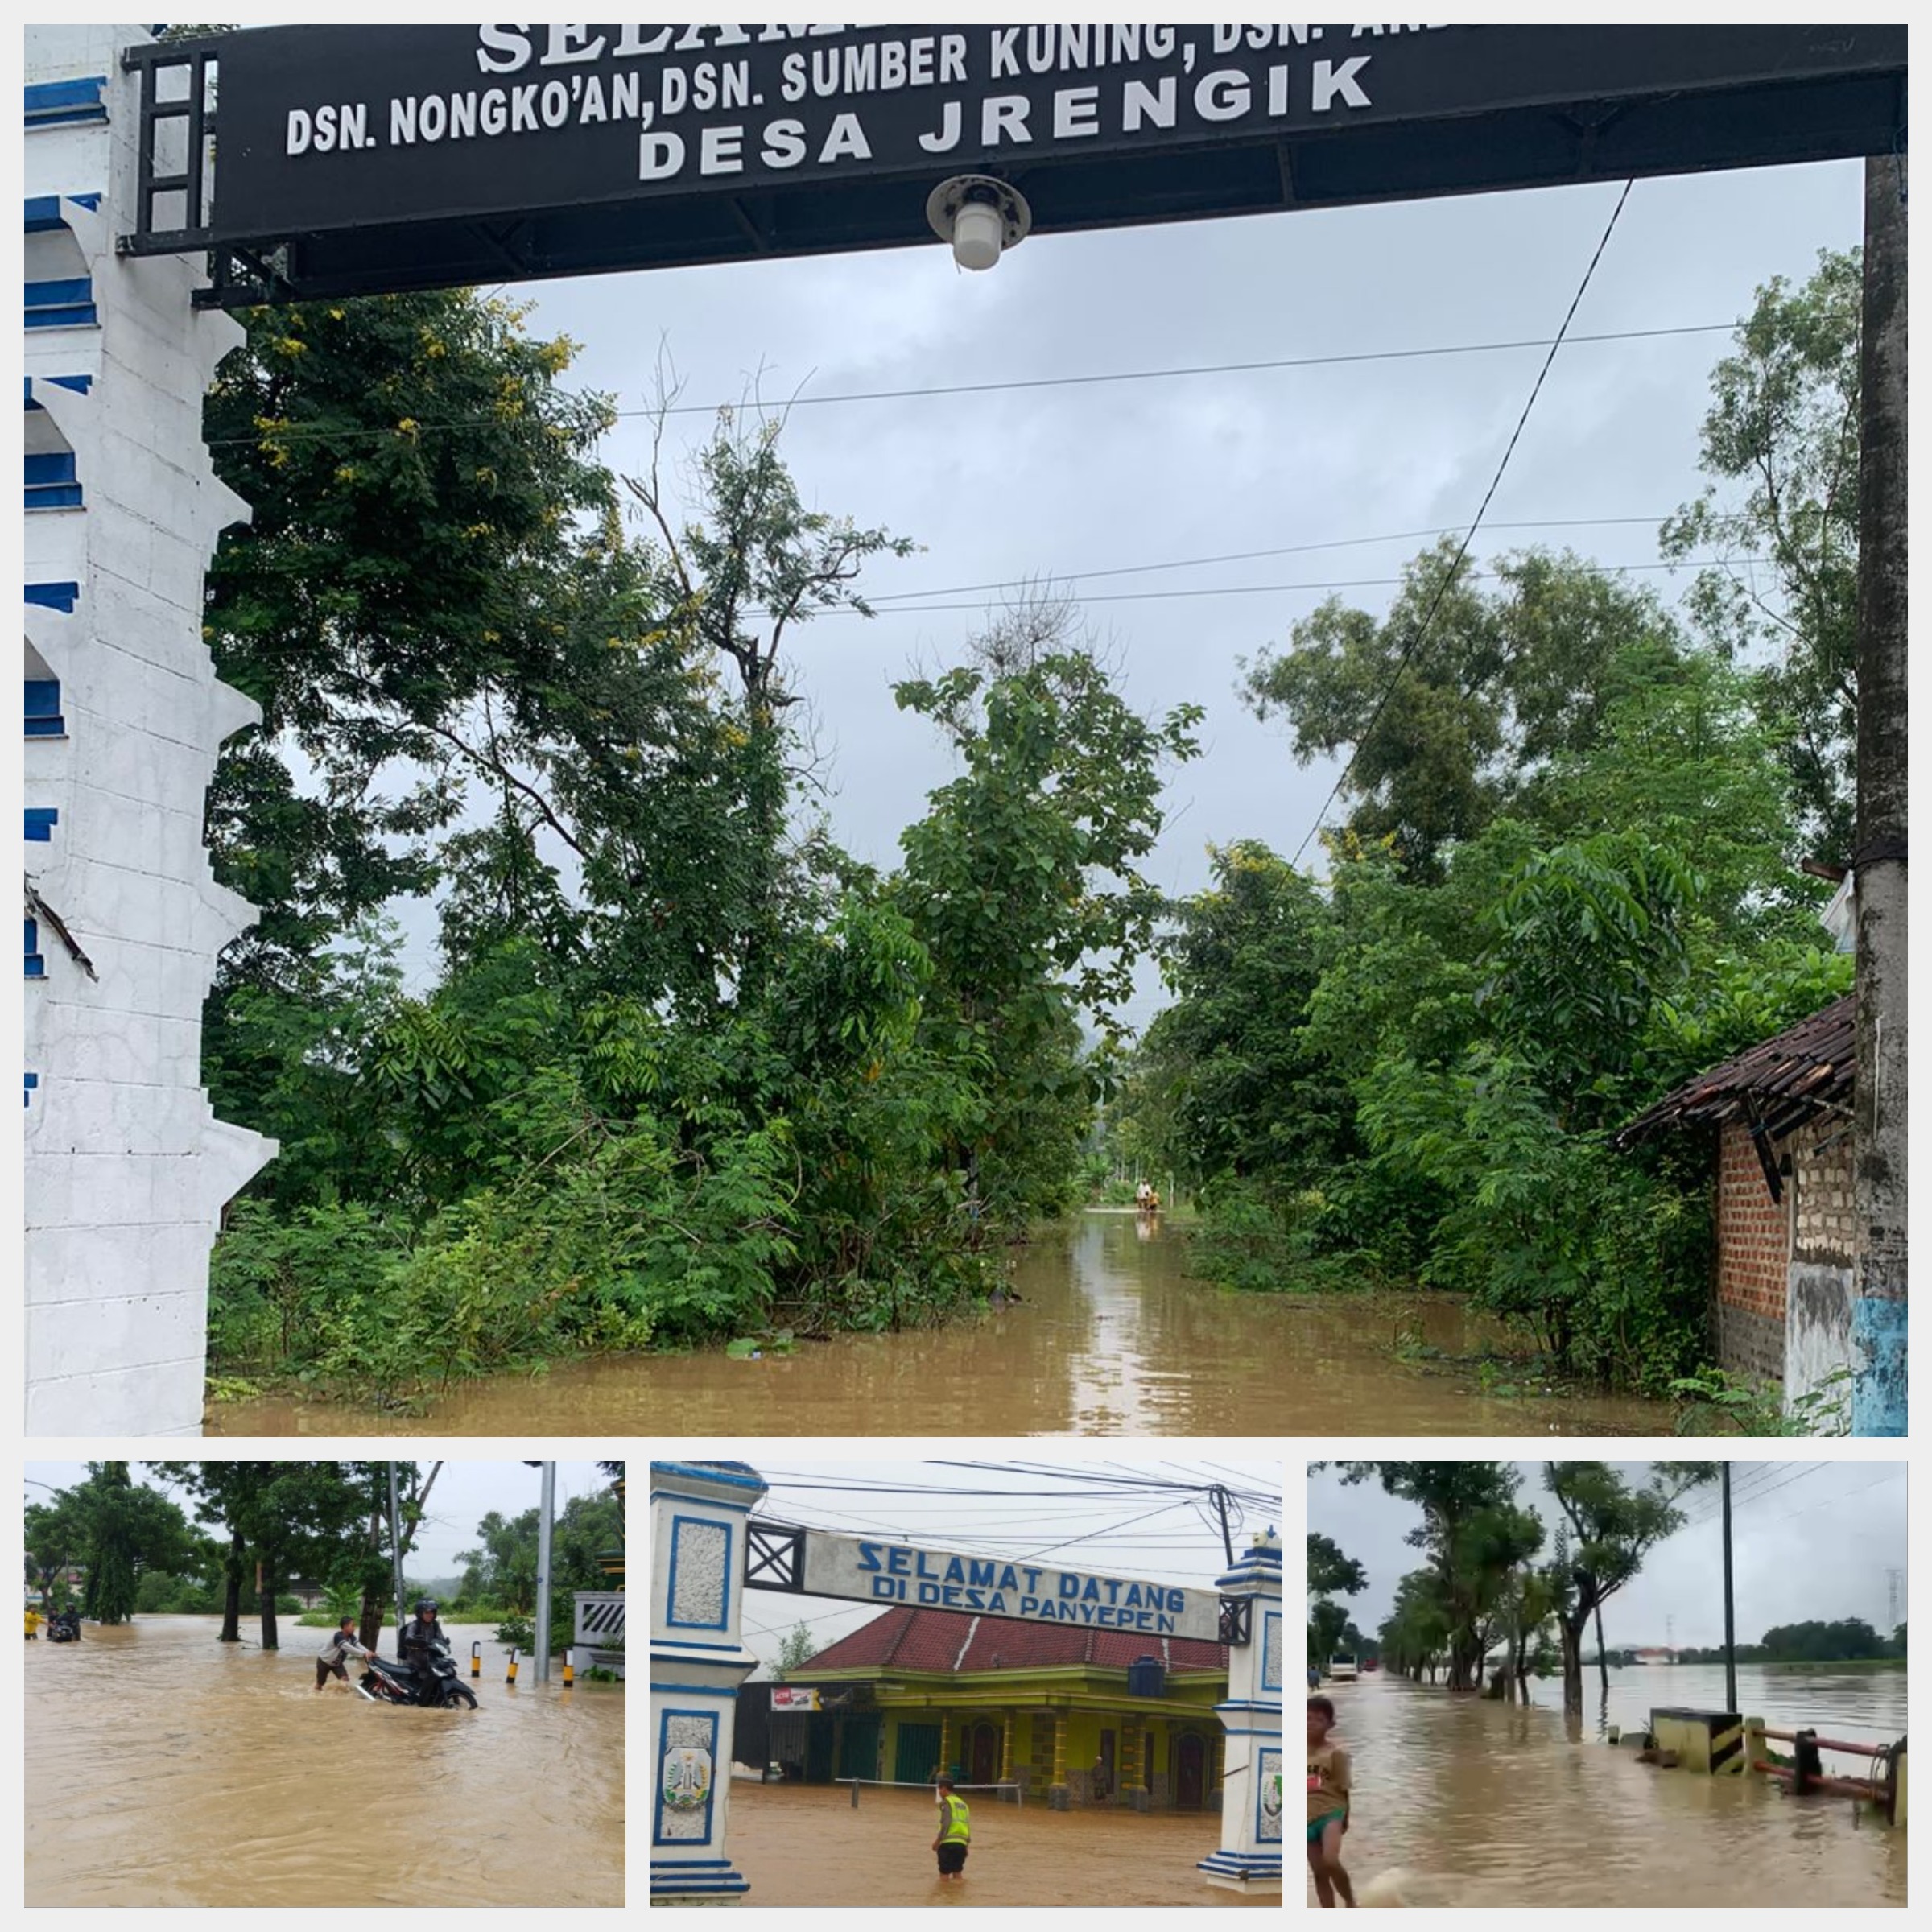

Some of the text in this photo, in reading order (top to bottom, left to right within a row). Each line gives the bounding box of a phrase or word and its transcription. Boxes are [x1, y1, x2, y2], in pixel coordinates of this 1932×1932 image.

[287, 102, 375, 155] DSN.
[781, 34, 968, 97] SUMBER
[990, 24, 1196, 79] KUNING,
[639, 55, 1372, 180] DESA JRENGIK
[857, 1542, 1185, 1612] SELAMAT DATANG
[873, 1575, 1175, 1633] DI DESA PANYEPEN
